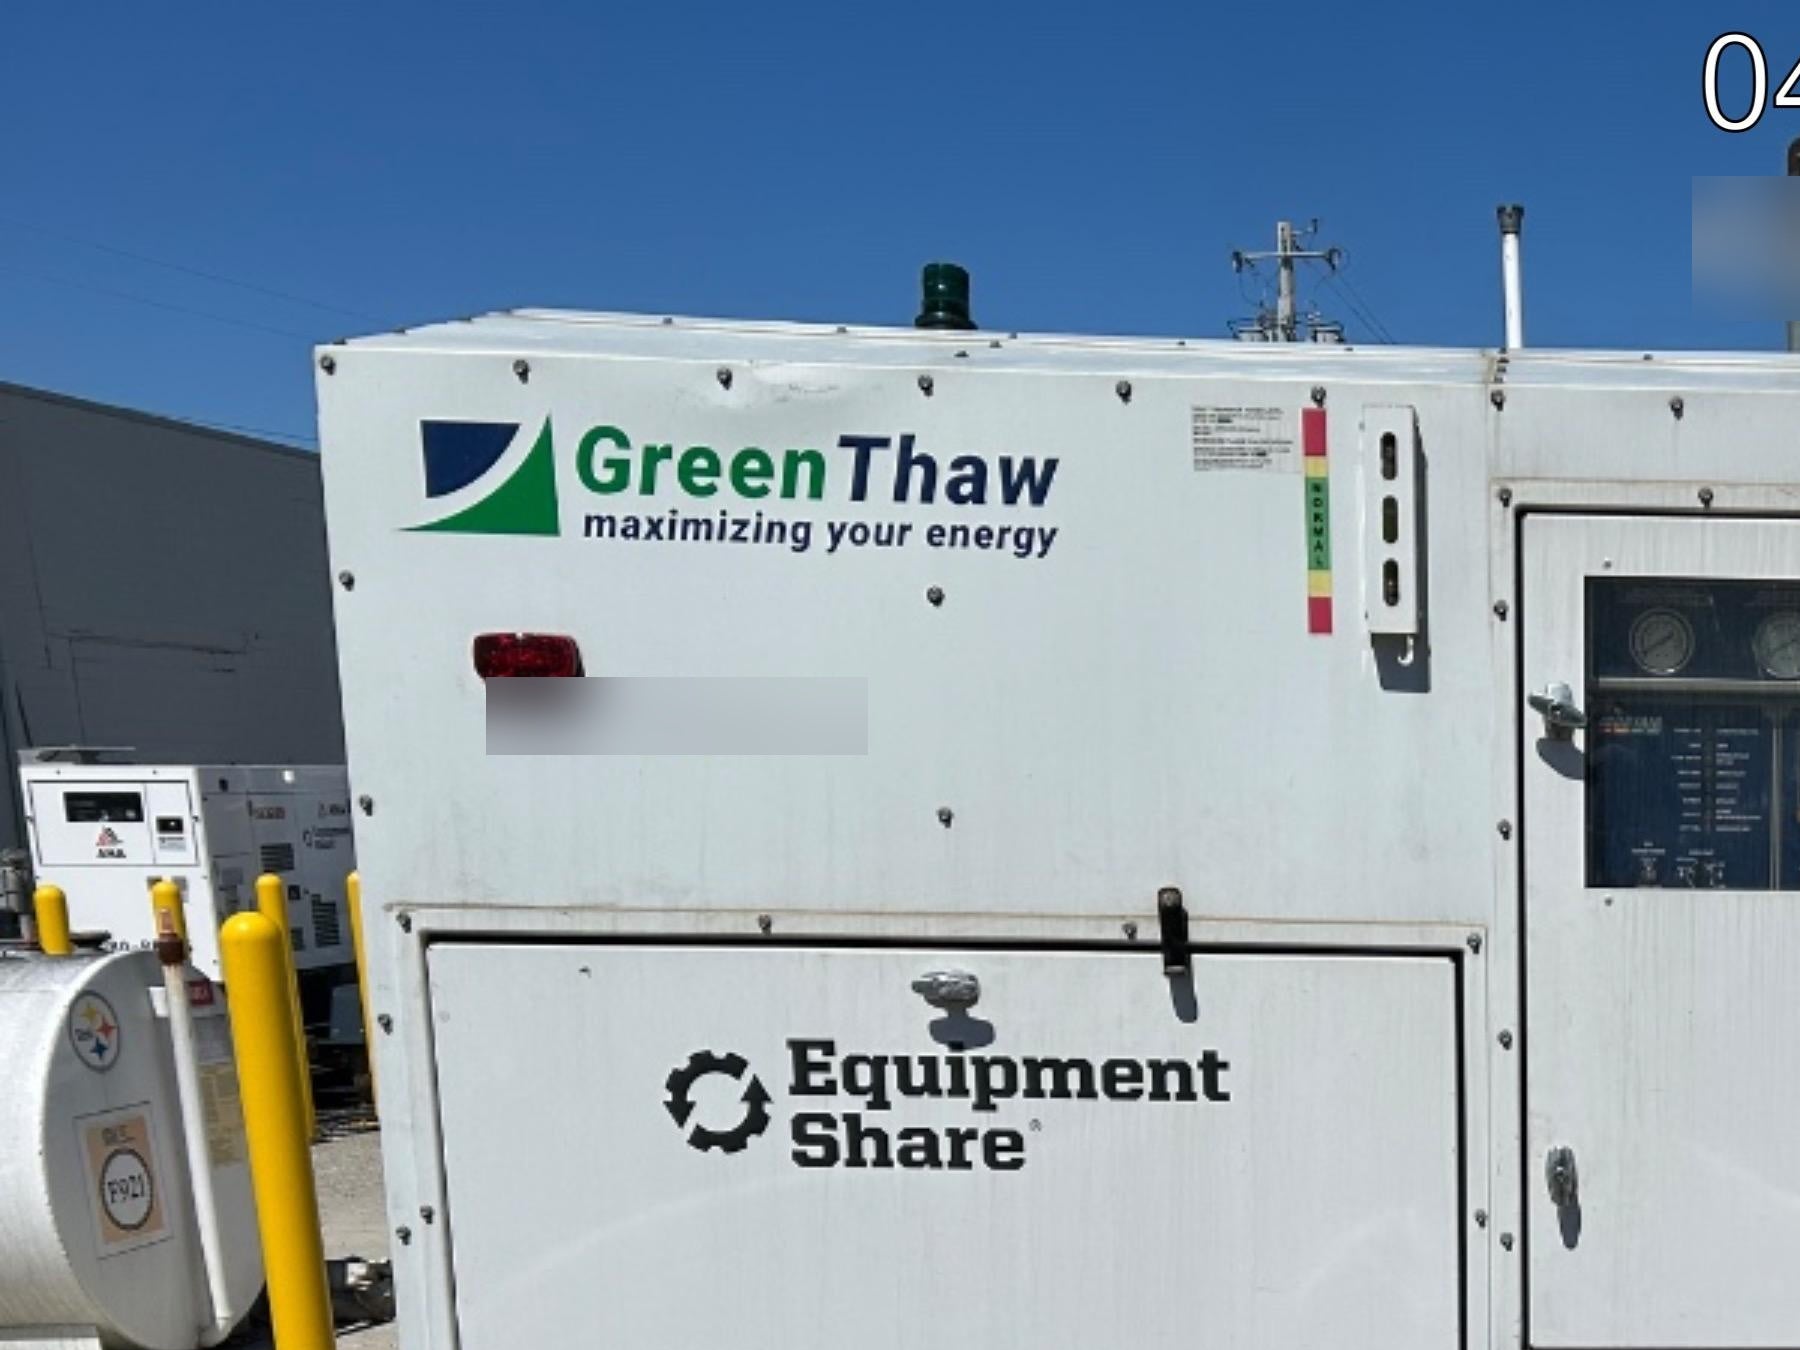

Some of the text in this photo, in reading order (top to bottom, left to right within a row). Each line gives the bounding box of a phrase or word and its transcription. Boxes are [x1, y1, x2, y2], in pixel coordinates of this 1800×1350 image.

[576, 425, 1060, 507] GreenThaw
[584, 508, 1060, 559] maximizing your energy
[786, 1038, 1230, 1112] Equipment
